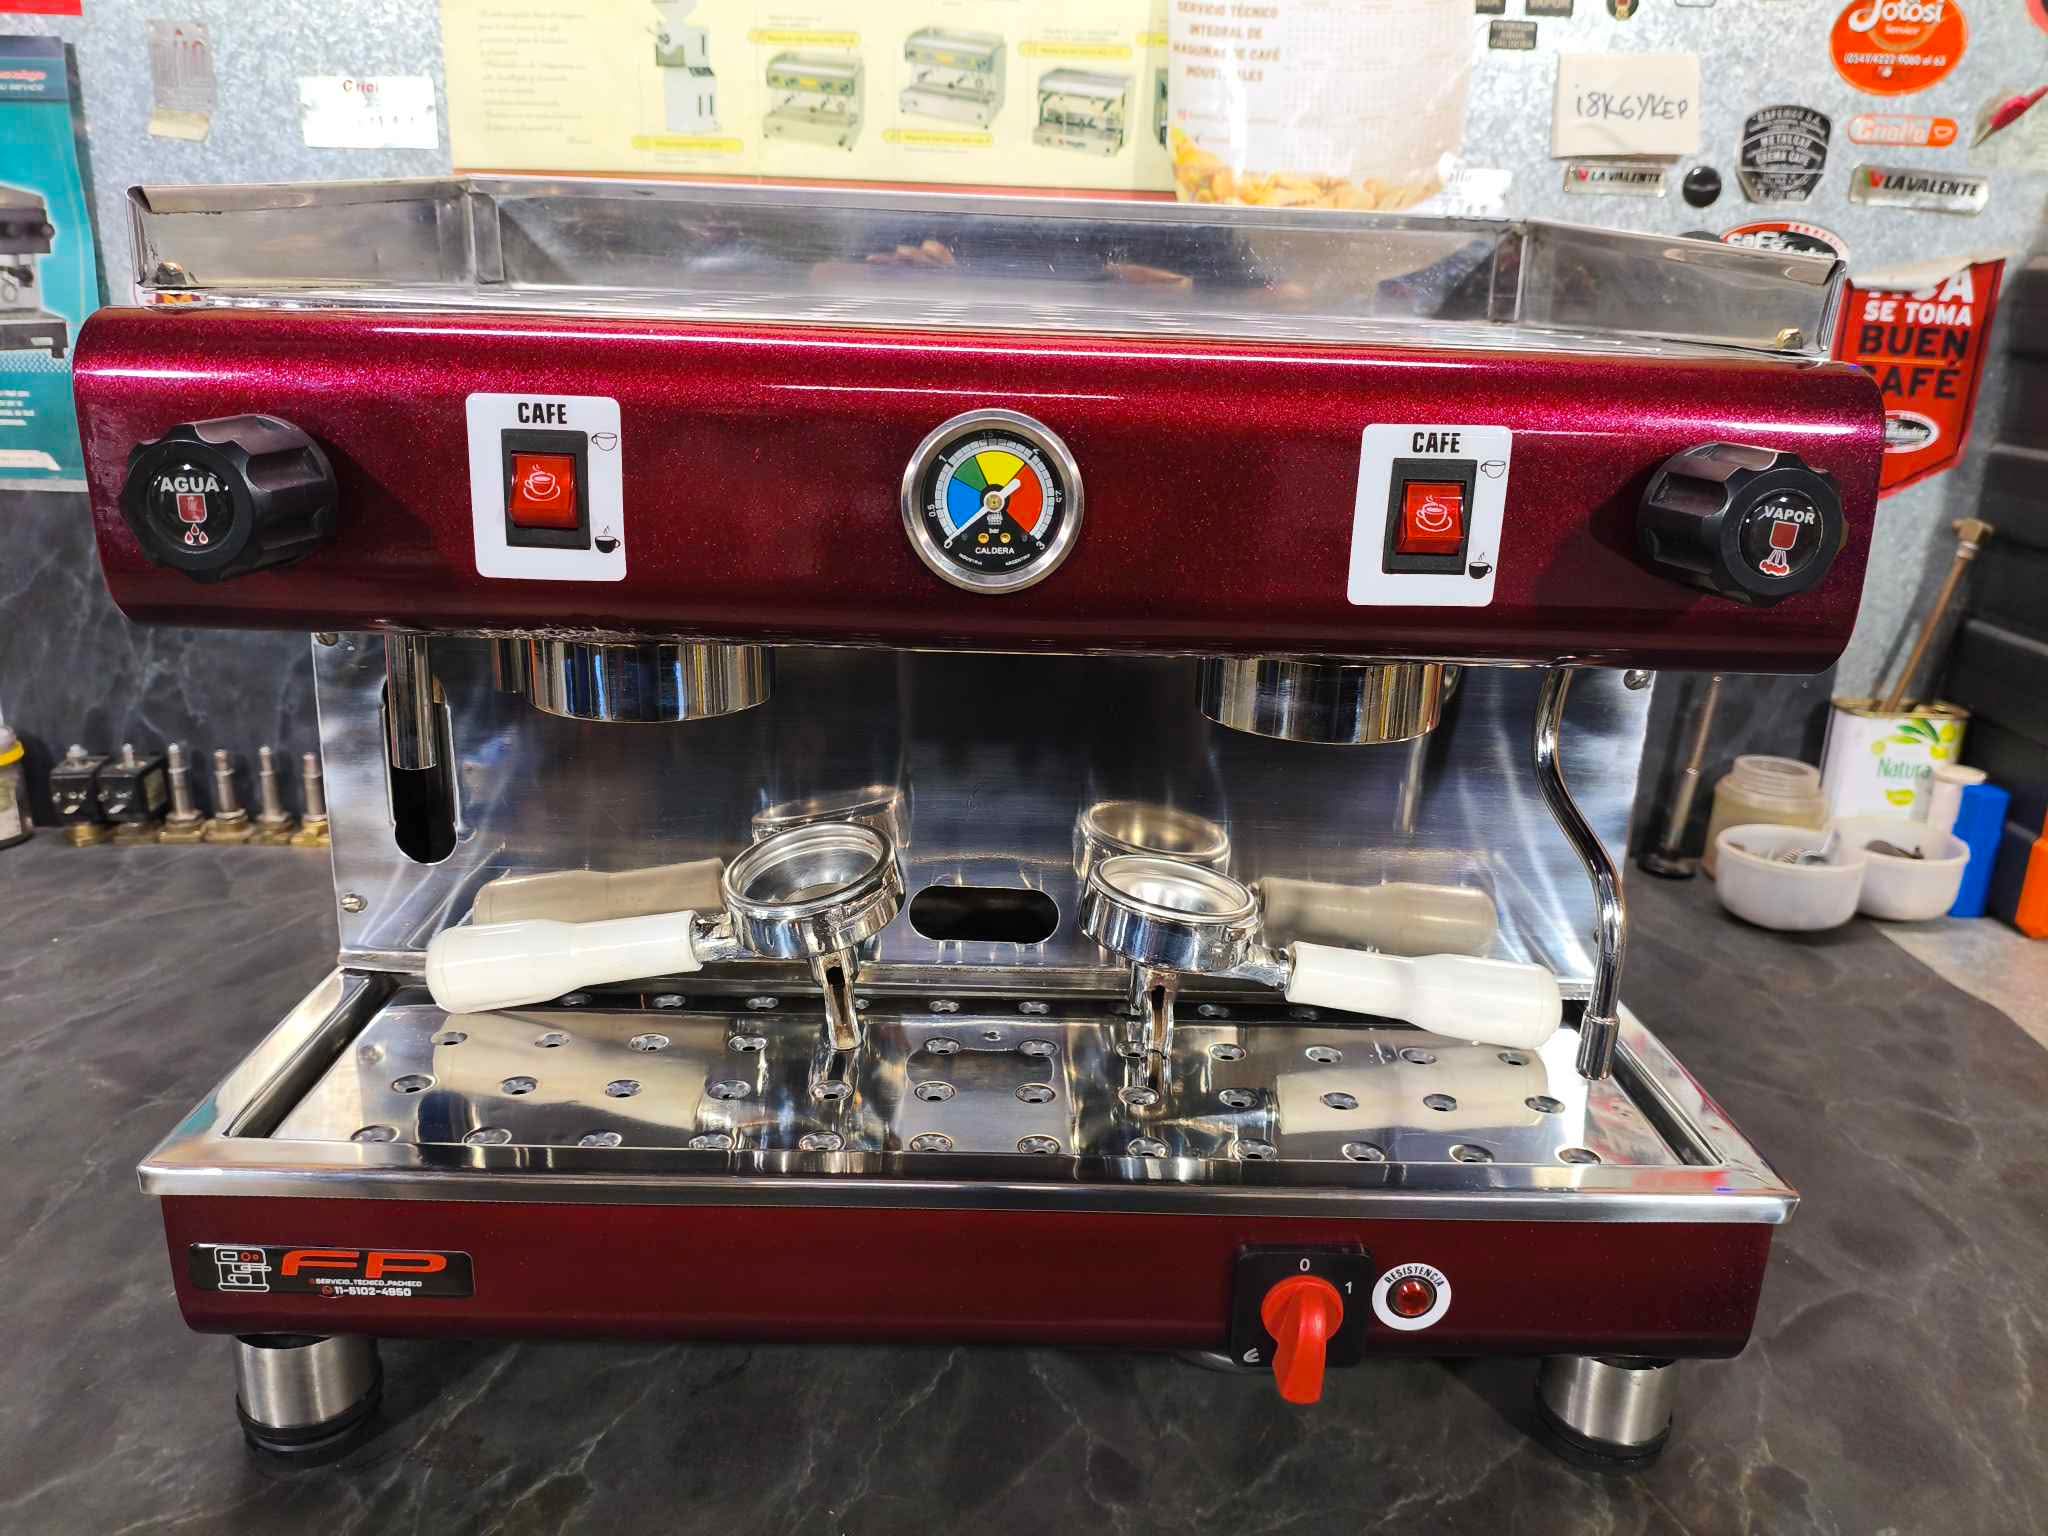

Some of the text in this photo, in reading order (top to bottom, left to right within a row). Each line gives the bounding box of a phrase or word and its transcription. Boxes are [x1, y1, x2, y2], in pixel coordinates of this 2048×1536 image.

[1863, 301, 1972, 326] SE TOMA
[1858, 325, 1970, 359] BUEN
[1865, 361, 1961, 399] AFÉ
[518, 402, 567, 425] CAFE
[1412, 432, 1461, 454] CAFE
[160, 476, 220, 493] AGUA
[1764, 505, 1816, 525] VAPOR
[975, 546, 1015, 555] CALDERA
[281, 1249, 448, 1279] FP
[1299, 1258, 1311, 1272] 0
[1384, 1265, 1445, 1288] RESISTENCIA
[1344, 1281, 1353, 1295] 1
